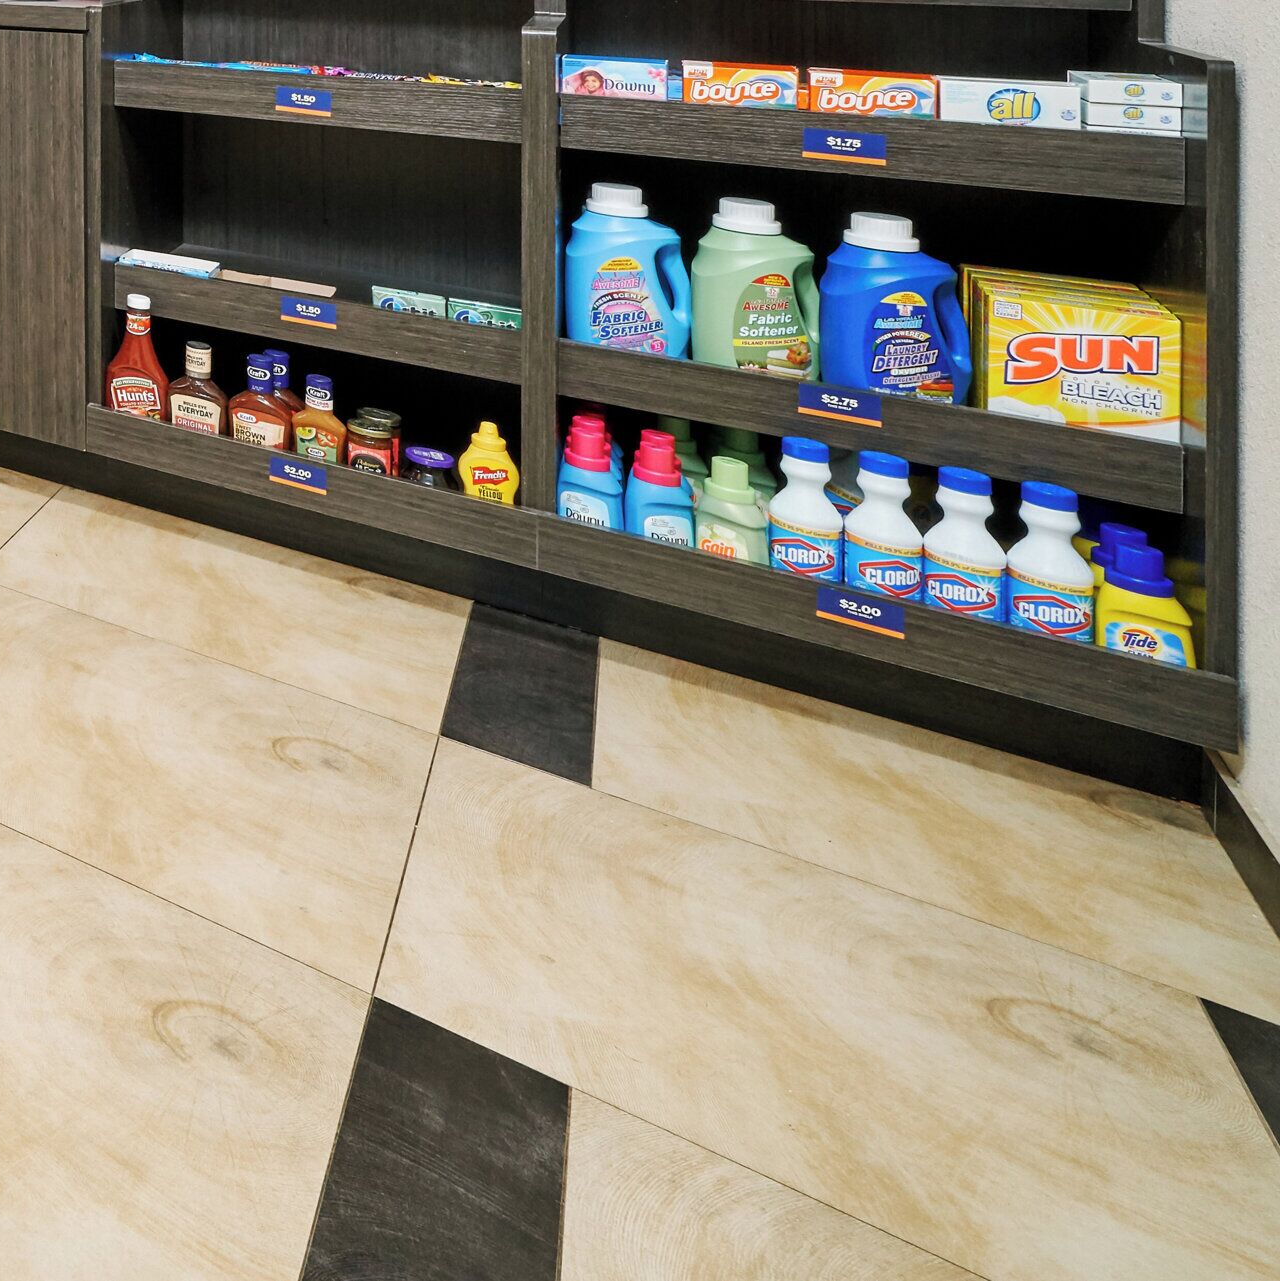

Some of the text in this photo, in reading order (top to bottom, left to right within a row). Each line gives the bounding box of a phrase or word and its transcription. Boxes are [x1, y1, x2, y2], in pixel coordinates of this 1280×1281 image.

[692, 79, 778, 100] bounce
[1125, 85, 1143, 97] all
[290, 93, 316, 103] $1.50
[819, 86, 916, 113] bounce
[990, 91, 1035, 121] all
[826, 137, 861, 148] $1.75
[295, 303, 321, 315] $1.50
[742, 300, 789, 312] AWESOME
[591, 310, 646, 327] FABRIC
[748, 313, 792, 326] Fabric
[599, 321, 663, 339] SOFTENER
[739, 324, 798, 337] Softener
[885, 344, 928, 357] LAUNDRY
[1004, 332, 1160, 384] SUN
[873, 351, 938, 372] DETERGENT
[248, 367, 270, 379] Kraft
[821, 393, 858, 408] $2.75
[1061, 380, 1162, 410] BLEACH
[178, 404, 214, 418] EVERYDAY
[177, 417, 212, 432] ORIGINAL
[234, 427, 266, 442] BROWN
[283, 466, 312, 480] $2.00
[473, 469, 508, 483] French's
[479, 488, 503, 502] YELLOW
[700, 538, 735, 559] Gain
[773, 544, 829, 564] CLOROX
[865, 567, 921, 586] CLOROX
[927, 579, 990, 603] CLOROX
[839, 598, 882, 618] $2.00
[1018, 601, 1087, 624] CLOROX
[1122, 632, 1158, 650] Tide
